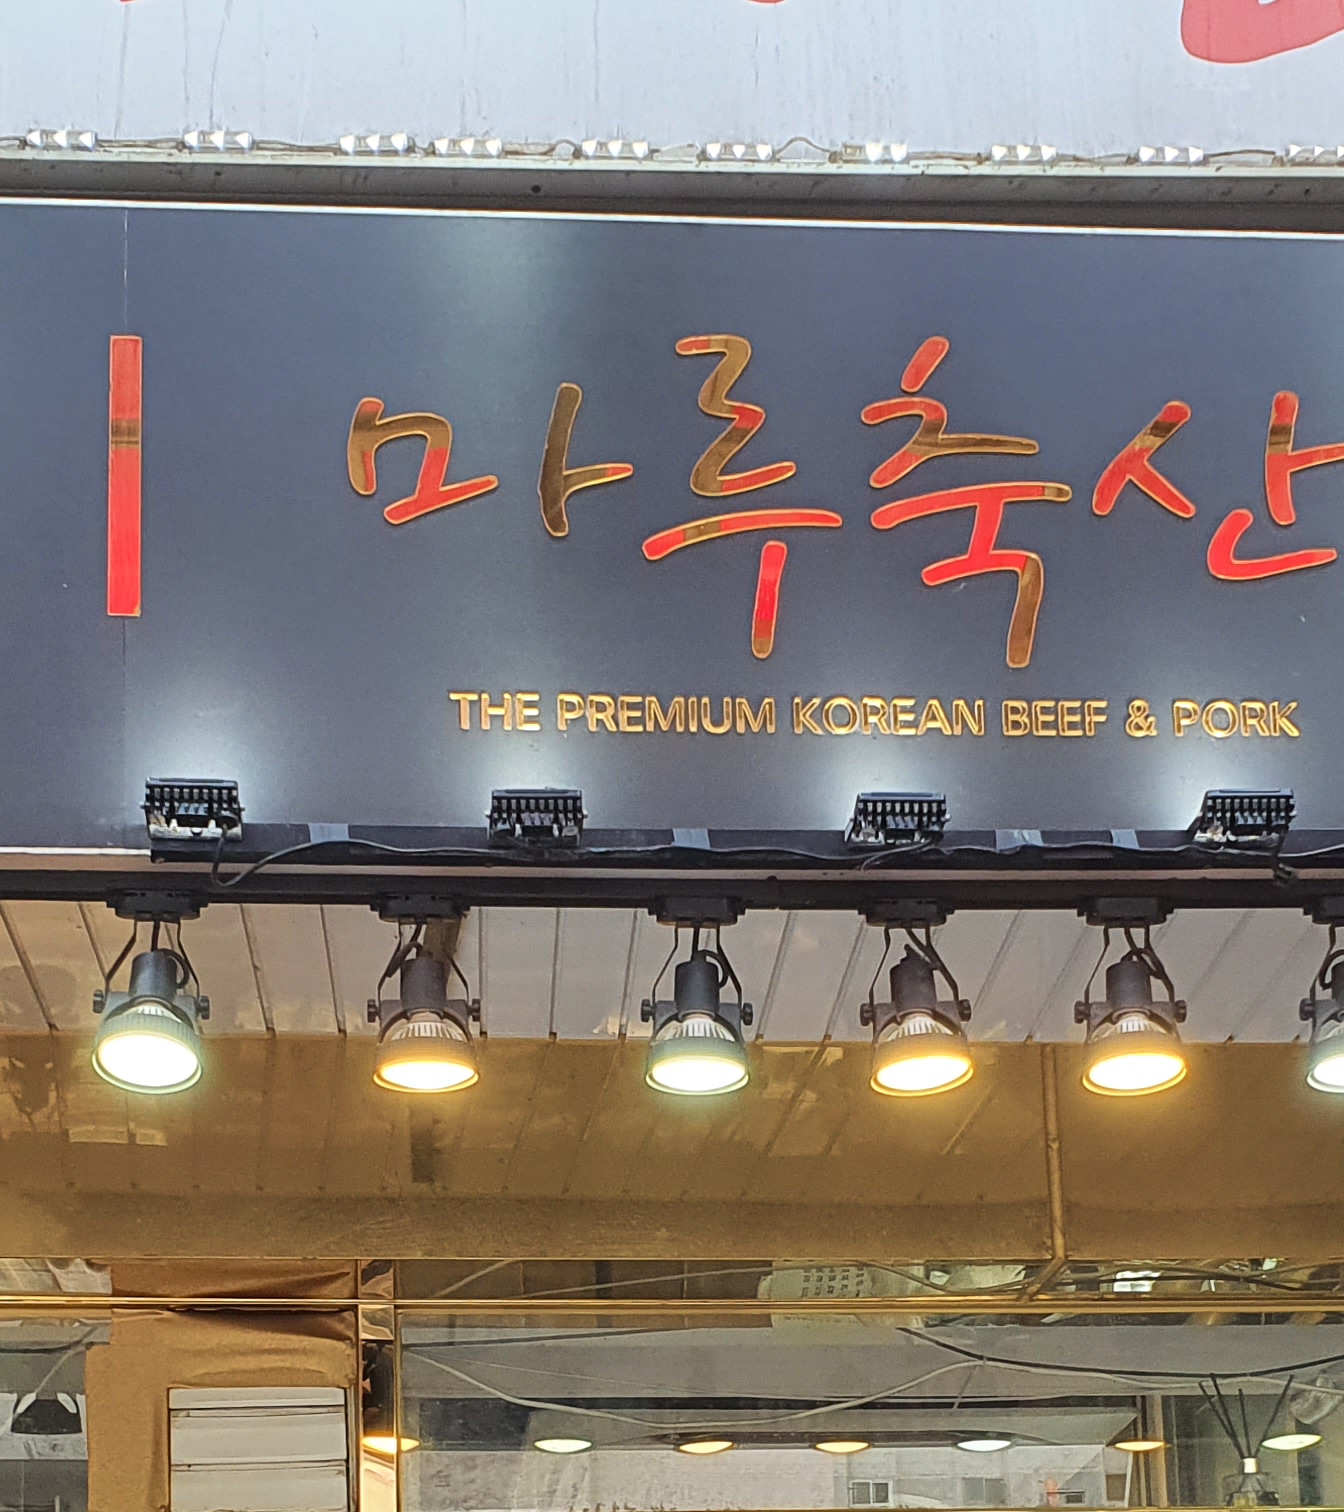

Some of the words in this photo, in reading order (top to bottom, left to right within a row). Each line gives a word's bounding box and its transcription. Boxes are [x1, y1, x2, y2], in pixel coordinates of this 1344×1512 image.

[450, 690, 540, 733] THE
[555, 692, 777, 736] PREMIUM
[791, 694, 985, 738] KOREAN
[1000, 696, 1108, 738] BEEF
[1125, 697, 1157, 737] &
[1173, 699, 1303, 739] PORK
